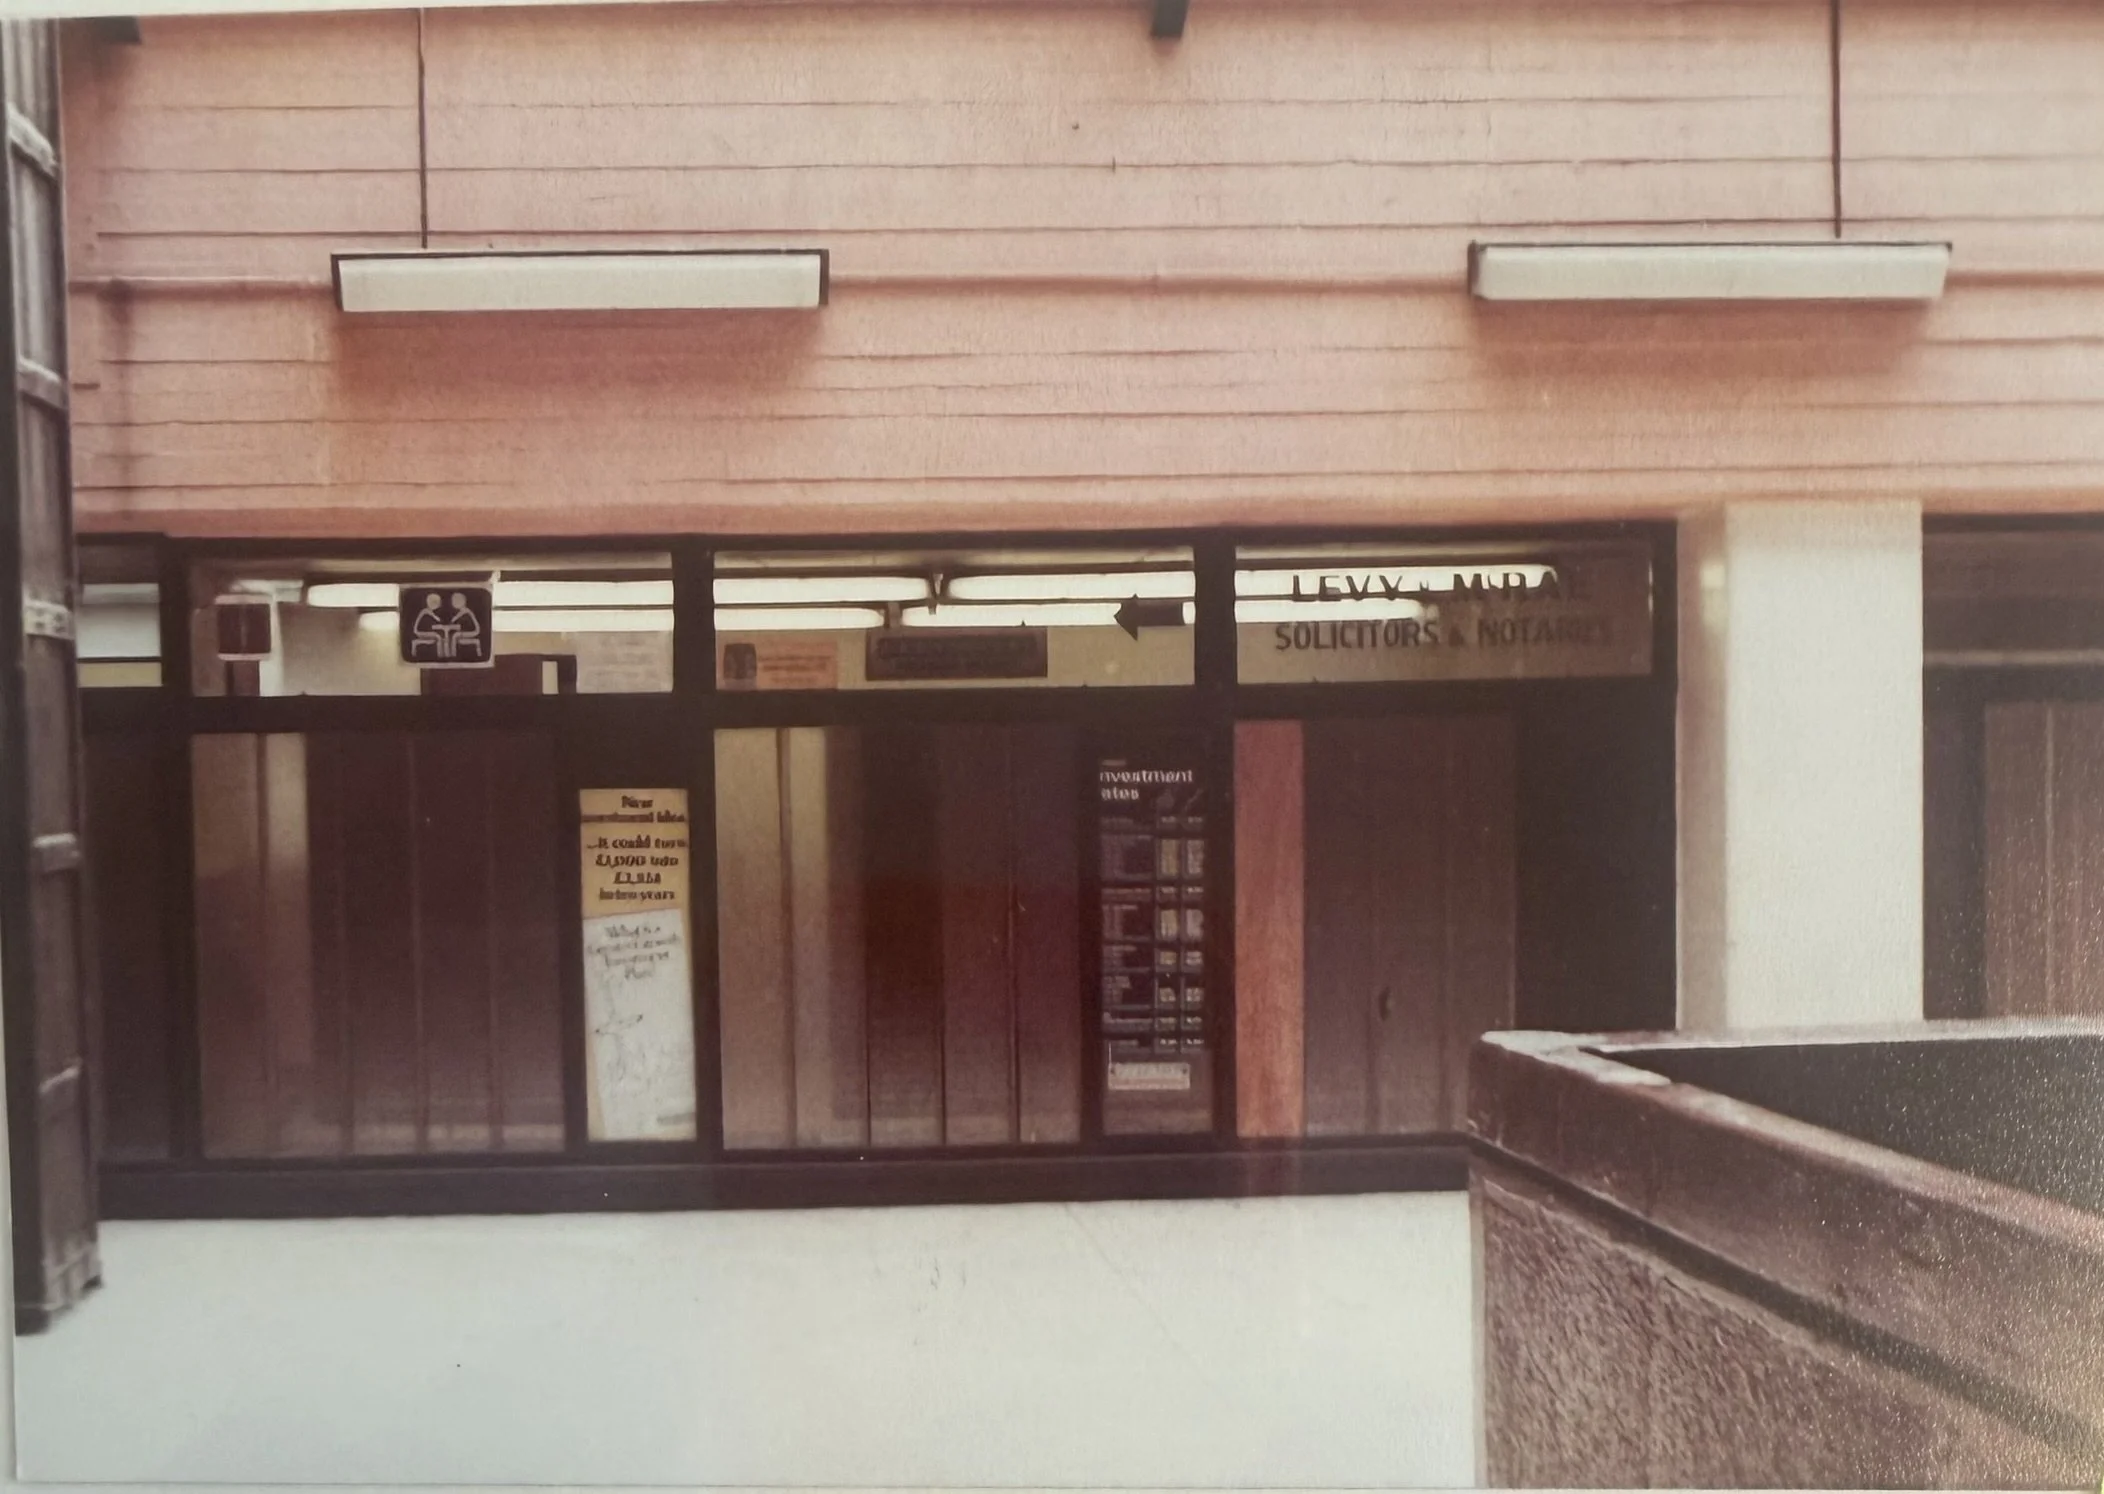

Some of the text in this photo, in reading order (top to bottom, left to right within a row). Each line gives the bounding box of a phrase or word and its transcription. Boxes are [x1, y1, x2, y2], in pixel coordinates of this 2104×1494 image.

[1291, 573, 1404, 601] LEVY
[1275, 619, 1440, 651] SOLICITORS
[1100, 769, 1193, 783] nvestment
[1101, 786, 1140, 800] ates
